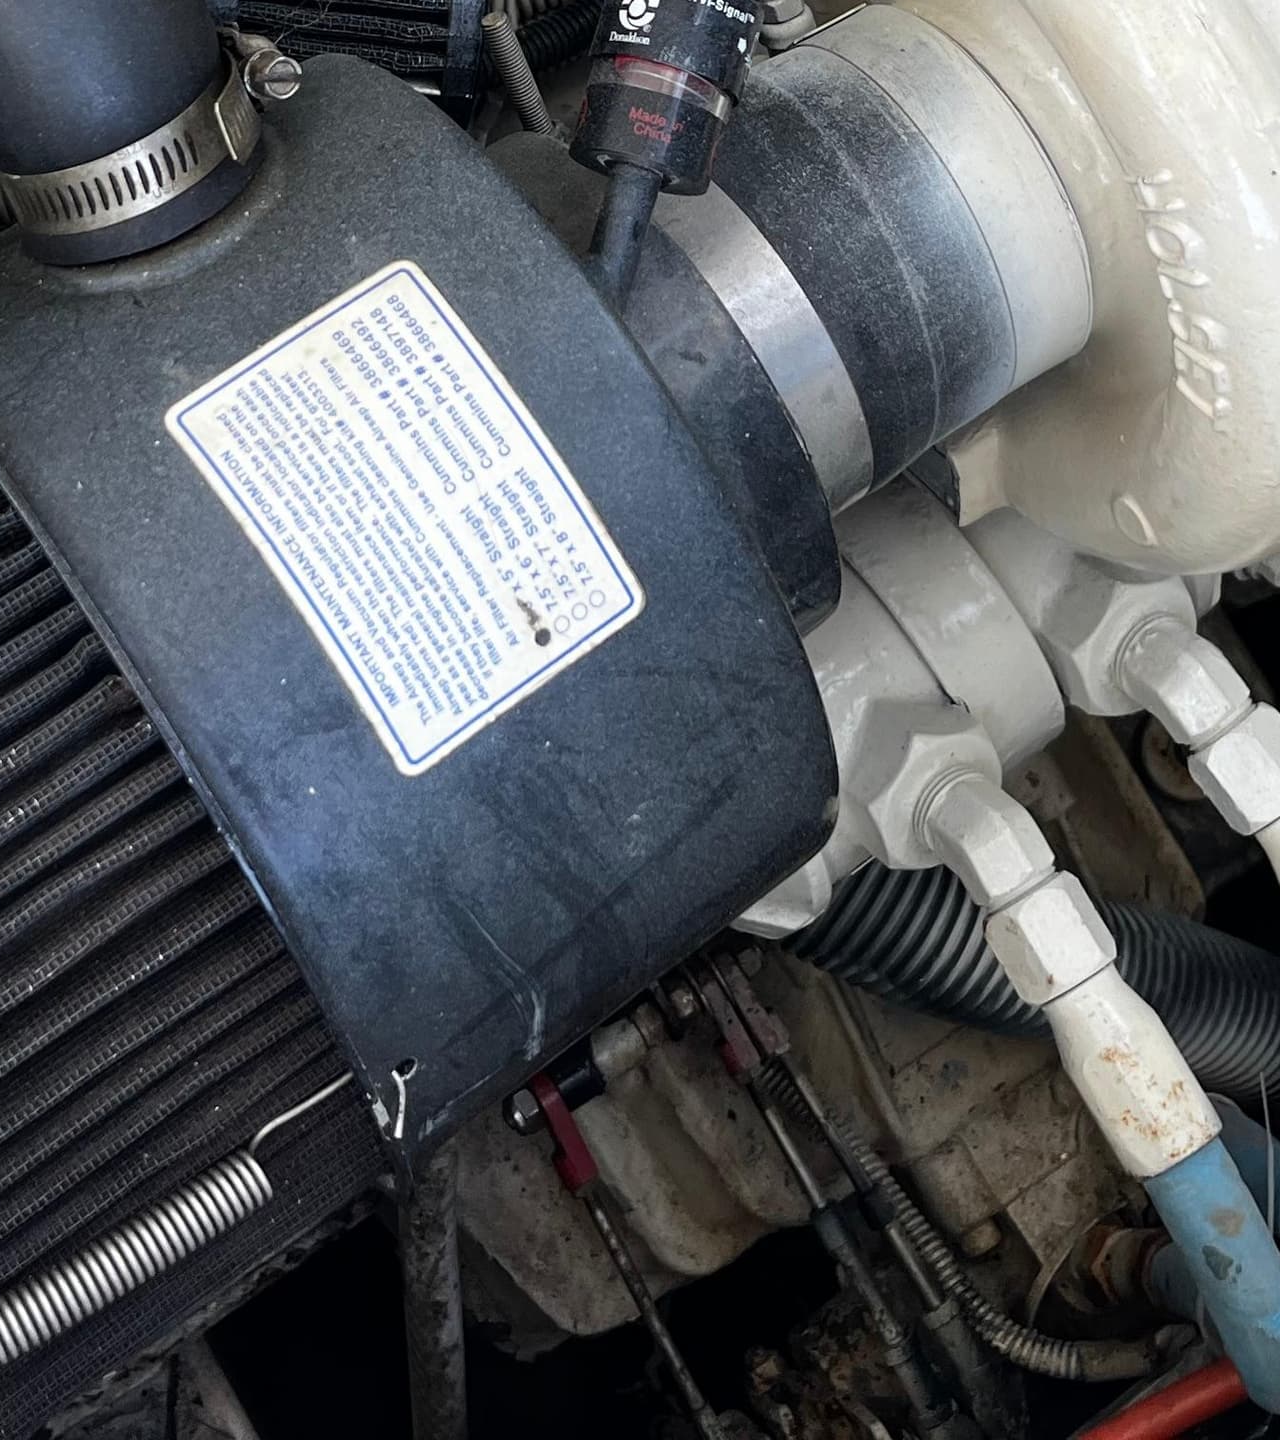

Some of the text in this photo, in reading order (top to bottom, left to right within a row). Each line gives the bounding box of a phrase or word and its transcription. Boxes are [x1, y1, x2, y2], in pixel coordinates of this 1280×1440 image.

[609, 30, 651, 46] Donaldson
[628, 106, 667, 128] Made
[633, 121, 672, 144] China
[369, 307, 418, 364] 3897148
[386, 294, 436, 352] 3866468
[331, 329, 382, 388] 3866469
[350, 317, 400, 376] 3866492
[256, 368, 296, 412] replaced
[279, 371, 318, 414] greatest
[319, 357, 347, 391] Filters
[421, 374, 449, 406] Part
[439, 362, 466, 394] Part
[227, 404, 247, 424] the
[235, 387, 258, 413] each
[248, 379, 293, 432] noticeable
[344, 390, 361, 406] Air
[385, 398, 412, 431] Part
[403, 386, 431, 418] Part
[215, 412, 252, 454] cleaned
[256, 412, 279, 439] once
[304, 426, 329, 456] must
[314, 415, 333, 436] For
[357, 406, 386, 442] Airsep
[445, 404, 493, 469] Cummins
[463, 392, 511, 457] Cummins
[253, 437, 289, 480] located
[273, 439, 314, 487] serviced
[352, 439, 389, 488] cleaning
[384, 442, 419, 490] Genuine
[409, 429, 456, 495] Cummins
[427, 416, 475, 482] Cummins
[260, 468, 286, 498] must
[305, 453, 330, 484] there
[327, 455, 353, 490] filters
[286, 479, 325, 528] indicator
[350, 488, 368, 513] The
[351, 466, 387, 510] exhaust
[417, 490, 435, 514] Use
[513, 466, 556, 525] Straight
[283, 498, 309, 532] filters
[324, 503, 344, 528] also
[344, 506, 366, 535] item
[384, 511, 404, 537] with
[387, 488, 426, 543] Cummins
[477, 491, 520, 550] Straight
[495, 479, 538, 537] Straight
[340, 528, 365, 558] must
[459, 504, 502, 563] Straight
[306, 532, 348, 589] Regulator
[323, 527, 365, 586] restriction
[363, 533, 415, 608] maintenance
[399, 537, 441, 593] saturated
[424, 543, 444, 570] with
[435, 519, 489, 597] Replacement
[220, 449, 400, 707] IMPORTANT MAINTENANCE INFORMATION
[362, 558, 387, 594] filters
[441, 569, 471, 613] service
[345, 588, 378, 638] Vacuum
[363, 587, 380, 610] the
[385, 593, 402, 619] The
[420, 592, 448, 633] engine
[485, 597, 509, 630] Filter
[376, 608, 400, 643] when
[410, 608, 445, 655] general
[438, 593, 472, 643] become
[373, 635, 395, 660] and
[468, 642, 487, 670] they
[482, 637, 502, 666] filter
[505, 629, 520, 647] Air
[392, 661, 419, 700] Airsep
[398, 642, 444, 714] immediately
[418, 646, 440, 679] turns
[454, 647, 489, 700] decrease
[415, 699, 432, 726] The
[437, 678, 463, 716] Airsep
[456, 681, 478, 707] year
